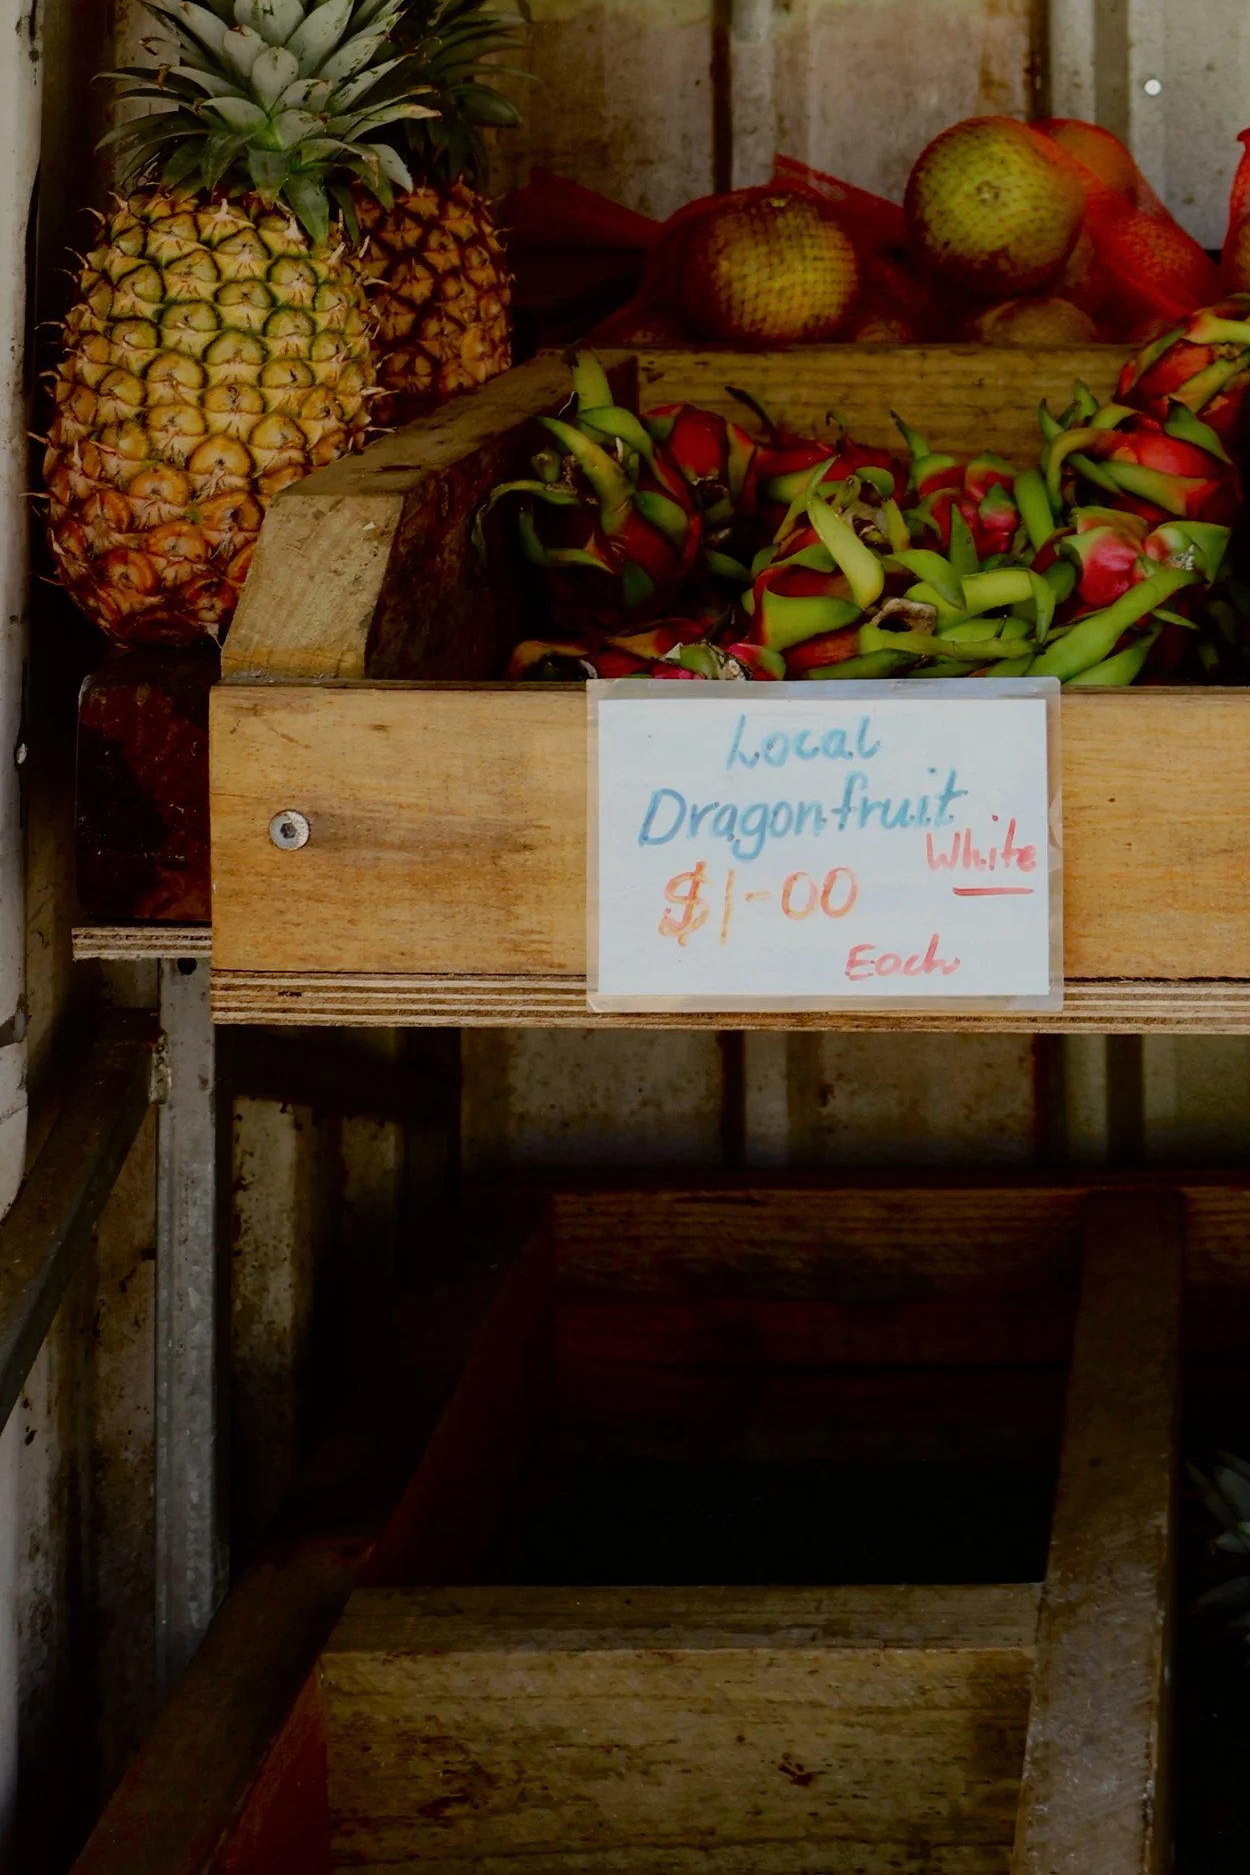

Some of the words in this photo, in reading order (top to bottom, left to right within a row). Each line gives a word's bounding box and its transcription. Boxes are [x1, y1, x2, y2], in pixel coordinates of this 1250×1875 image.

[725, 713, 881, 771] Local
[638, 767, 969, 862] Dragonfruit
[925, 813, 1038, 874] White
[844, 932, 960, 982] Each
